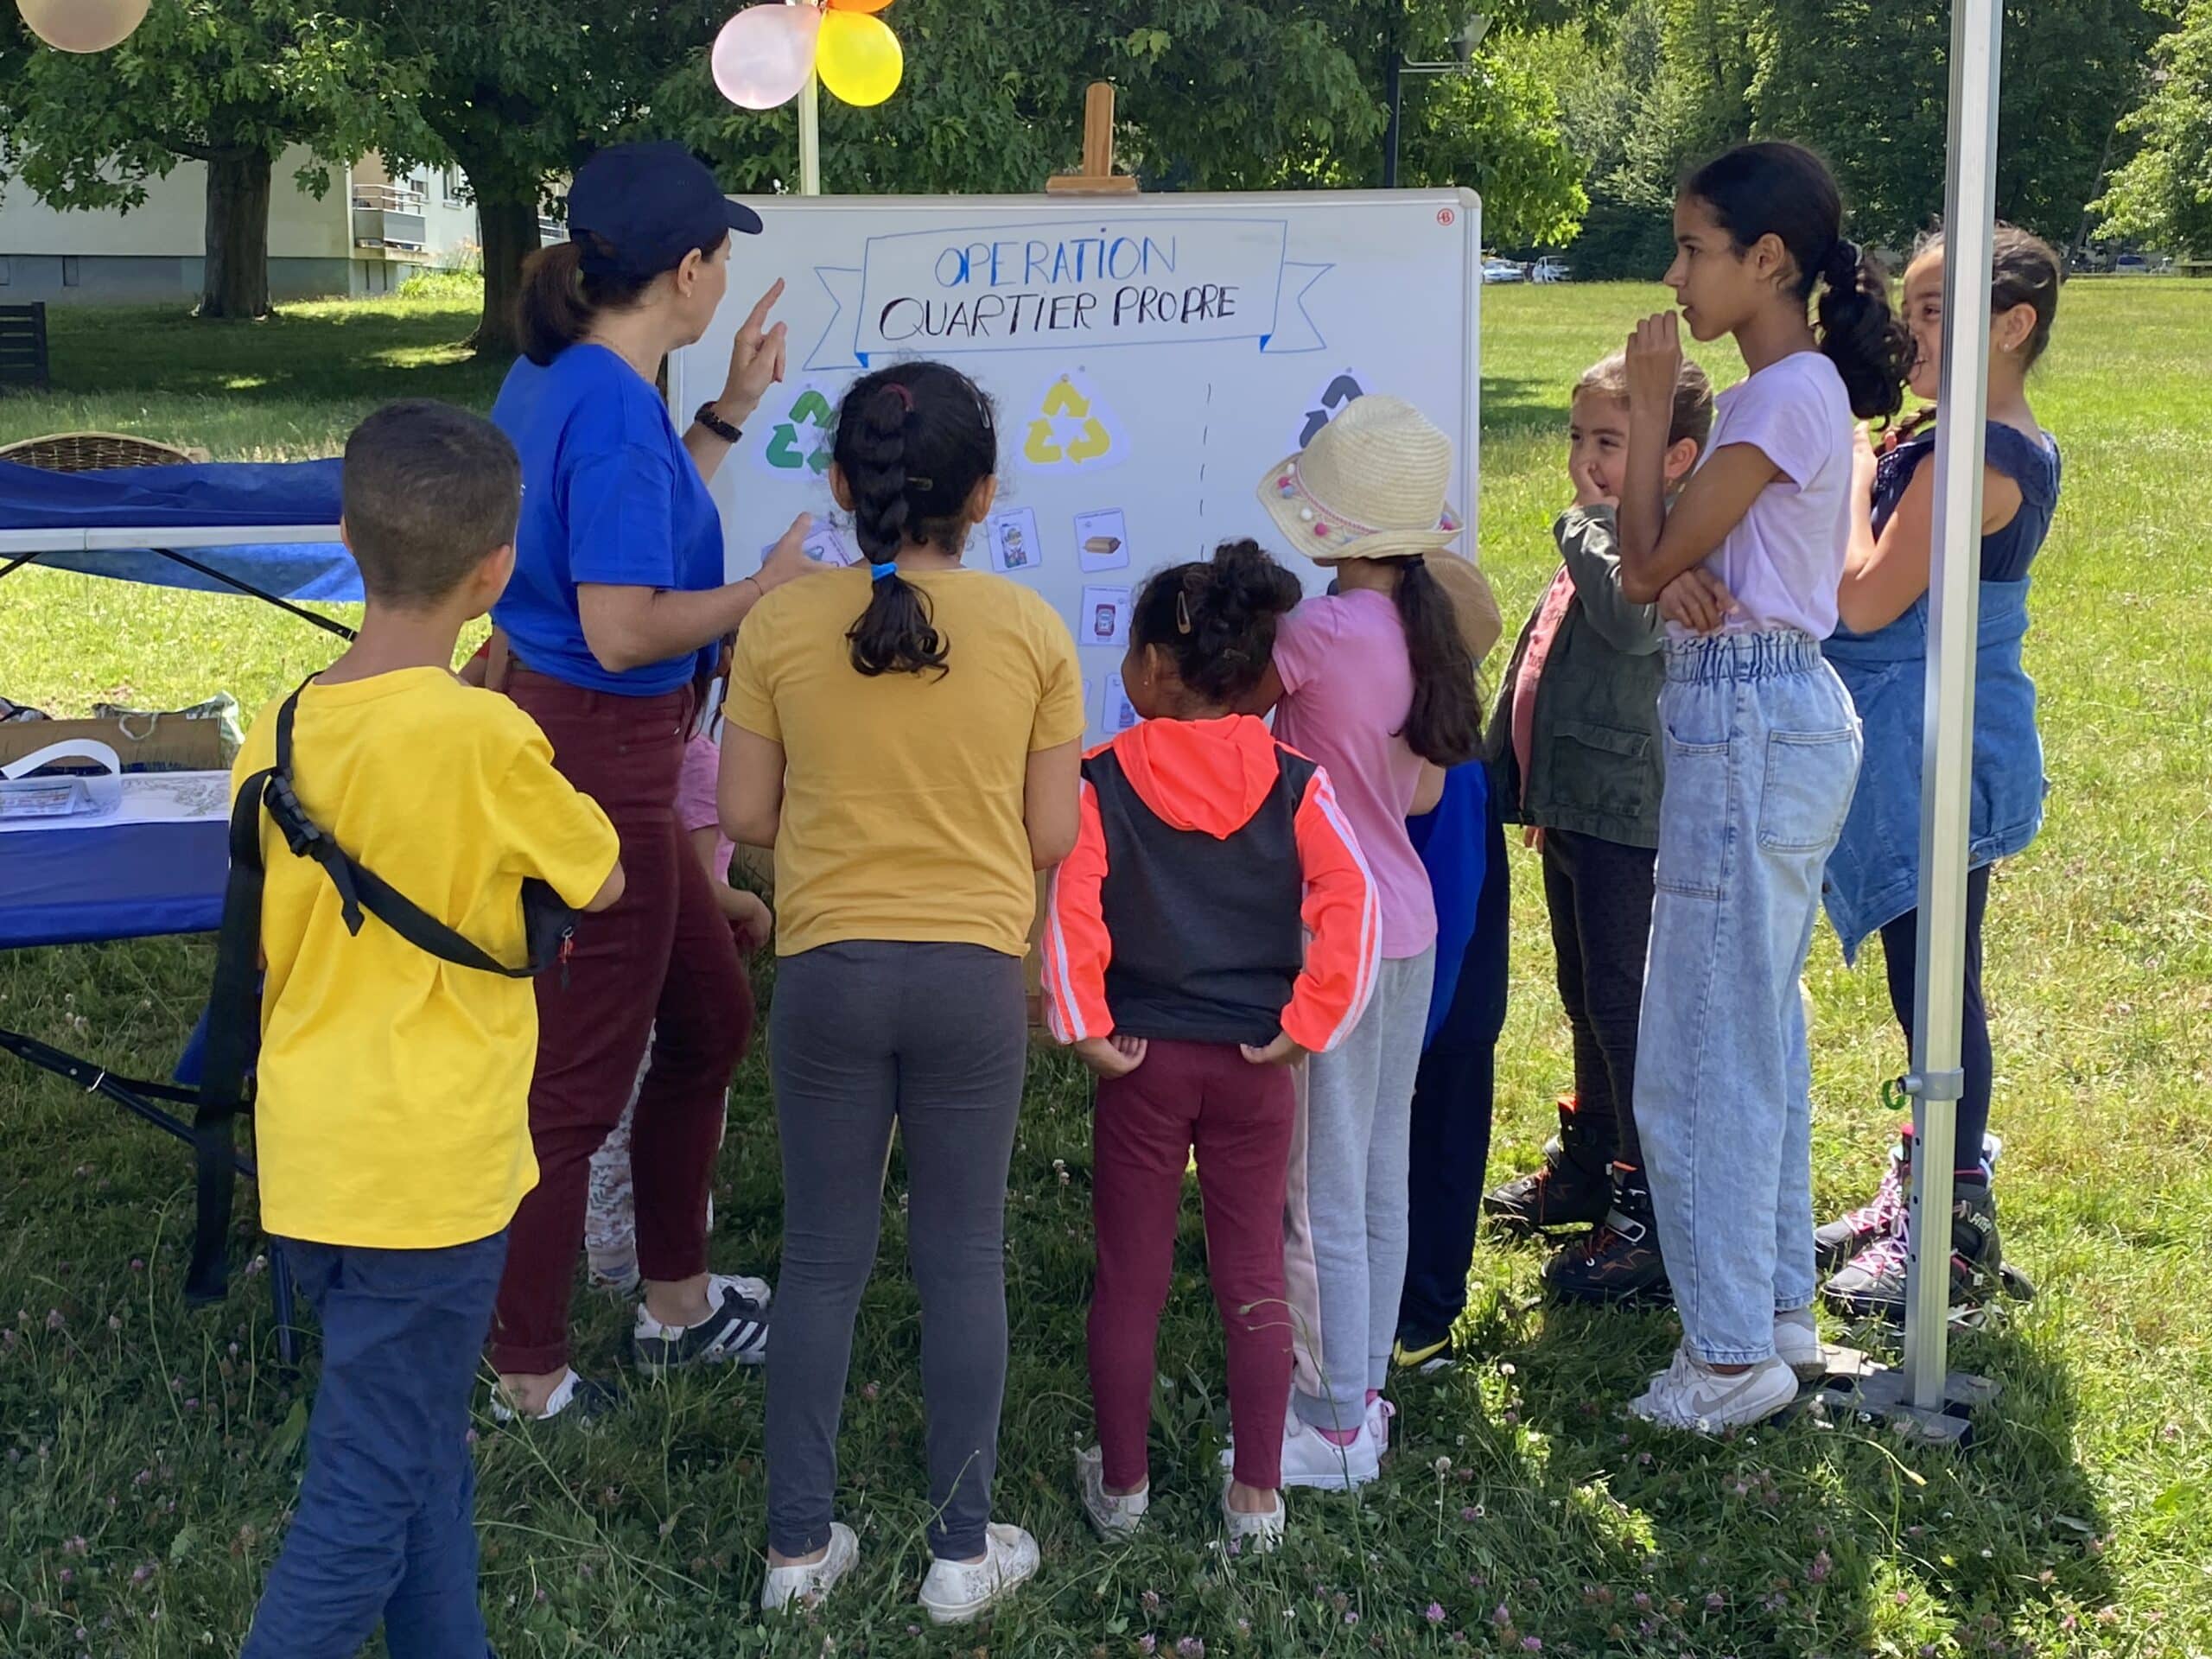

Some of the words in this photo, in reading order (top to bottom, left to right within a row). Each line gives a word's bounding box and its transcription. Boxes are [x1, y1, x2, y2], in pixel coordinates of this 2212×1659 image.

[935, 227, 1176, 288] OPERATION
[879, 291, 1097, 340] QUARTIER
[1113, 283, 1240, 327] PROPRE
